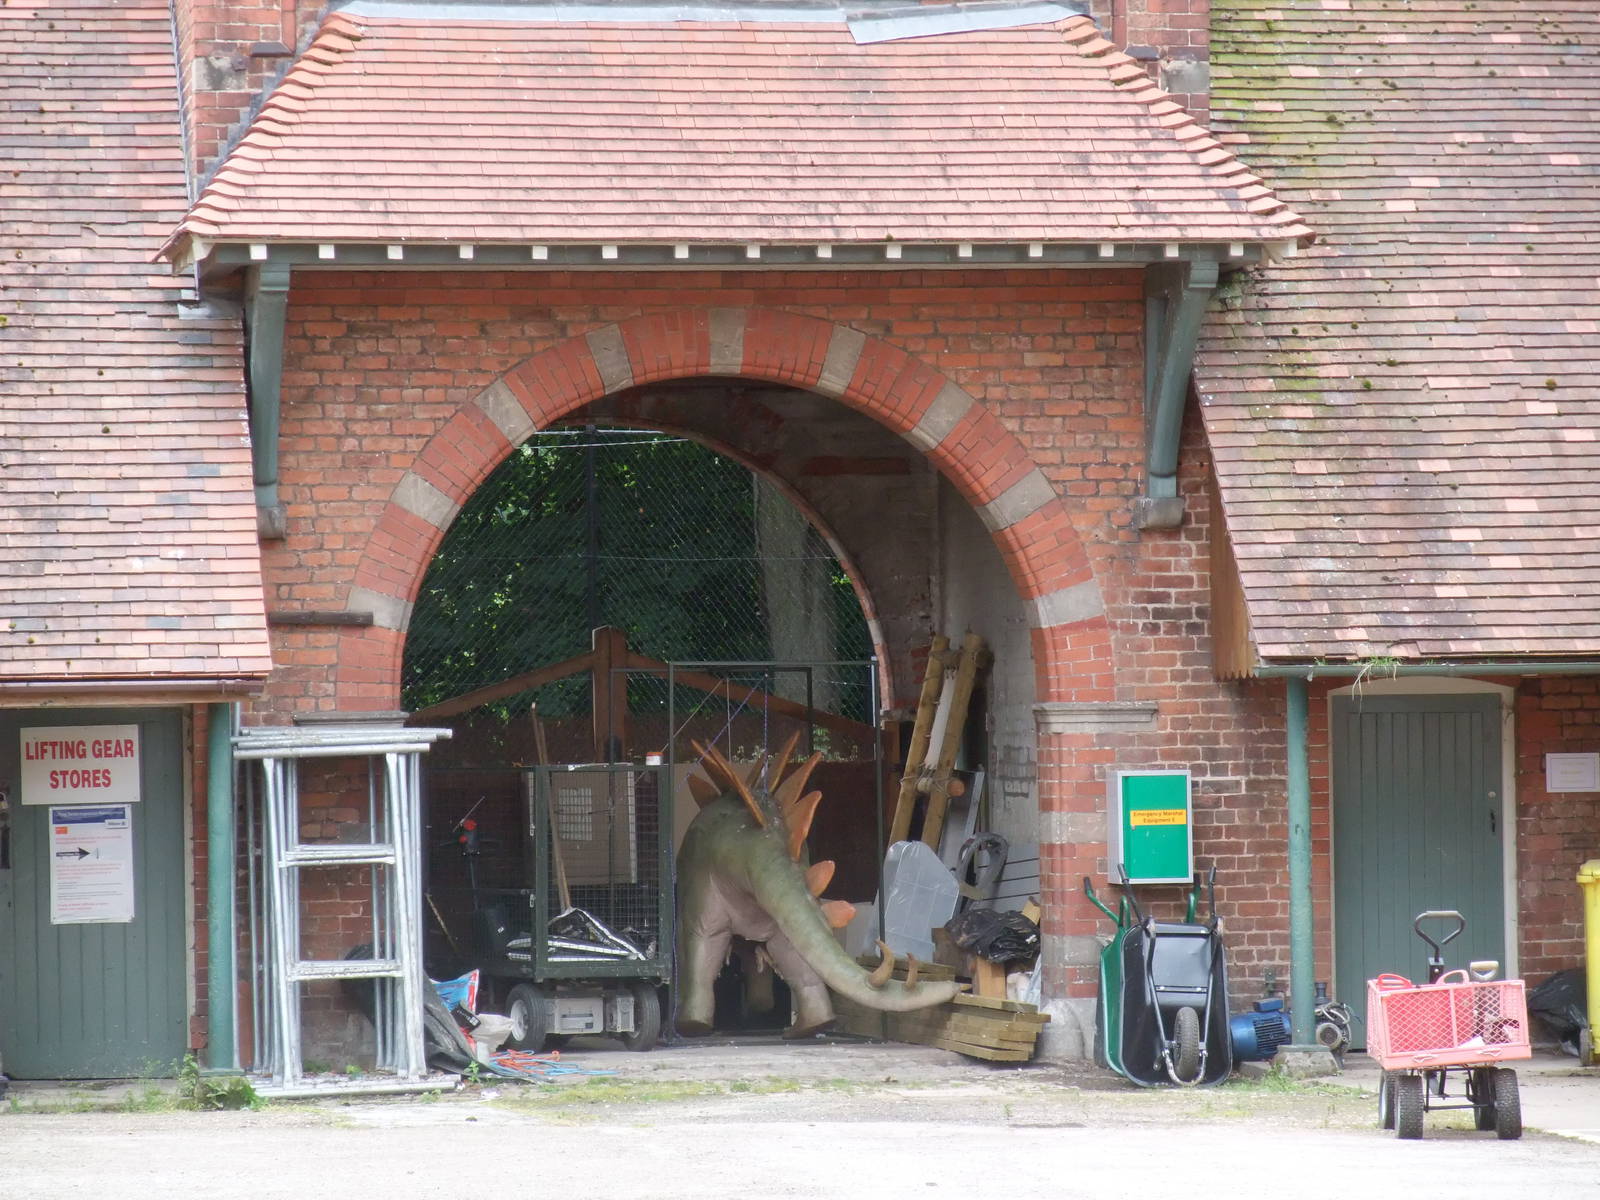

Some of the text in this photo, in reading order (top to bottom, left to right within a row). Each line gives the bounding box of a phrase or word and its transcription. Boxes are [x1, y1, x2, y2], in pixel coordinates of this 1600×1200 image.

[25, 739, 135, 760] LIFTING GEAR
[49, 769, 112, 789] STORES
